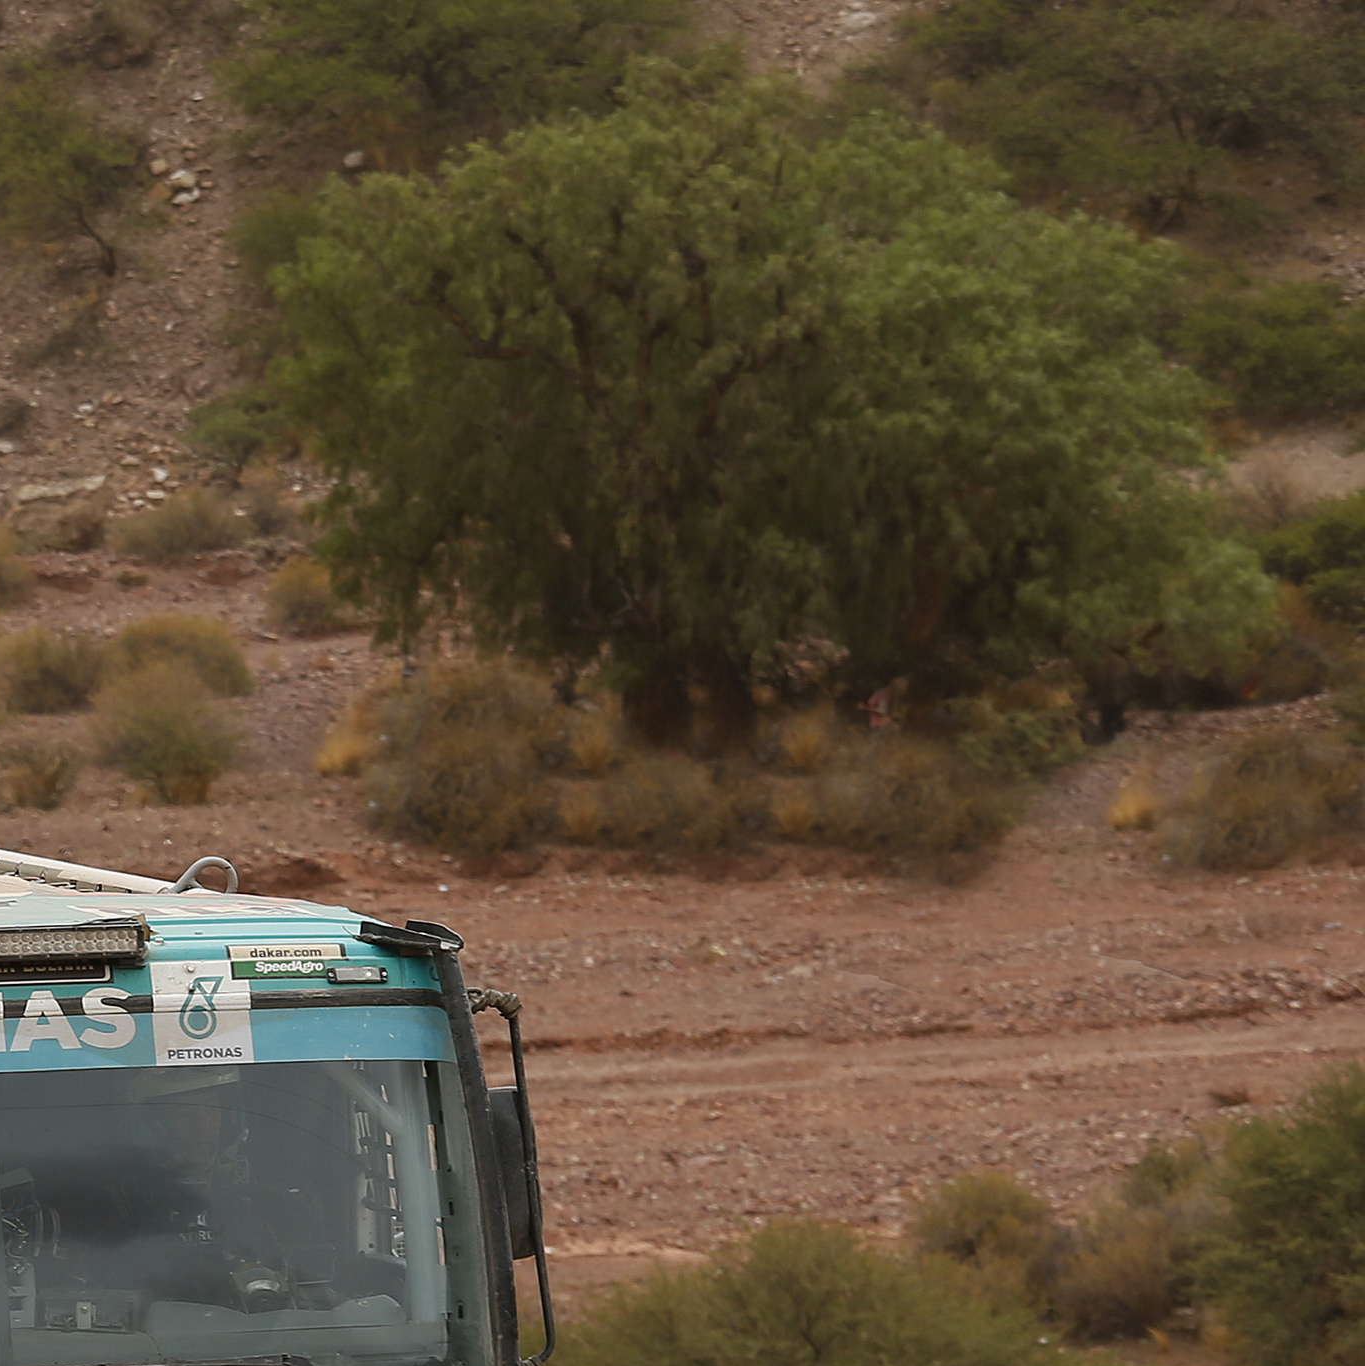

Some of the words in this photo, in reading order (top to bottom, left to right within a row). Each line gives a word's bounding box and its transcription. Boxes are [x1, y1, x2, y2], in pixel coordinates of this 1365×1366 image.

[250, 947, 322, 959] dakar.com
[254, 960, 324, 974] SpeedAgro
[168, 1047, 243, 1060] PETRONAS
